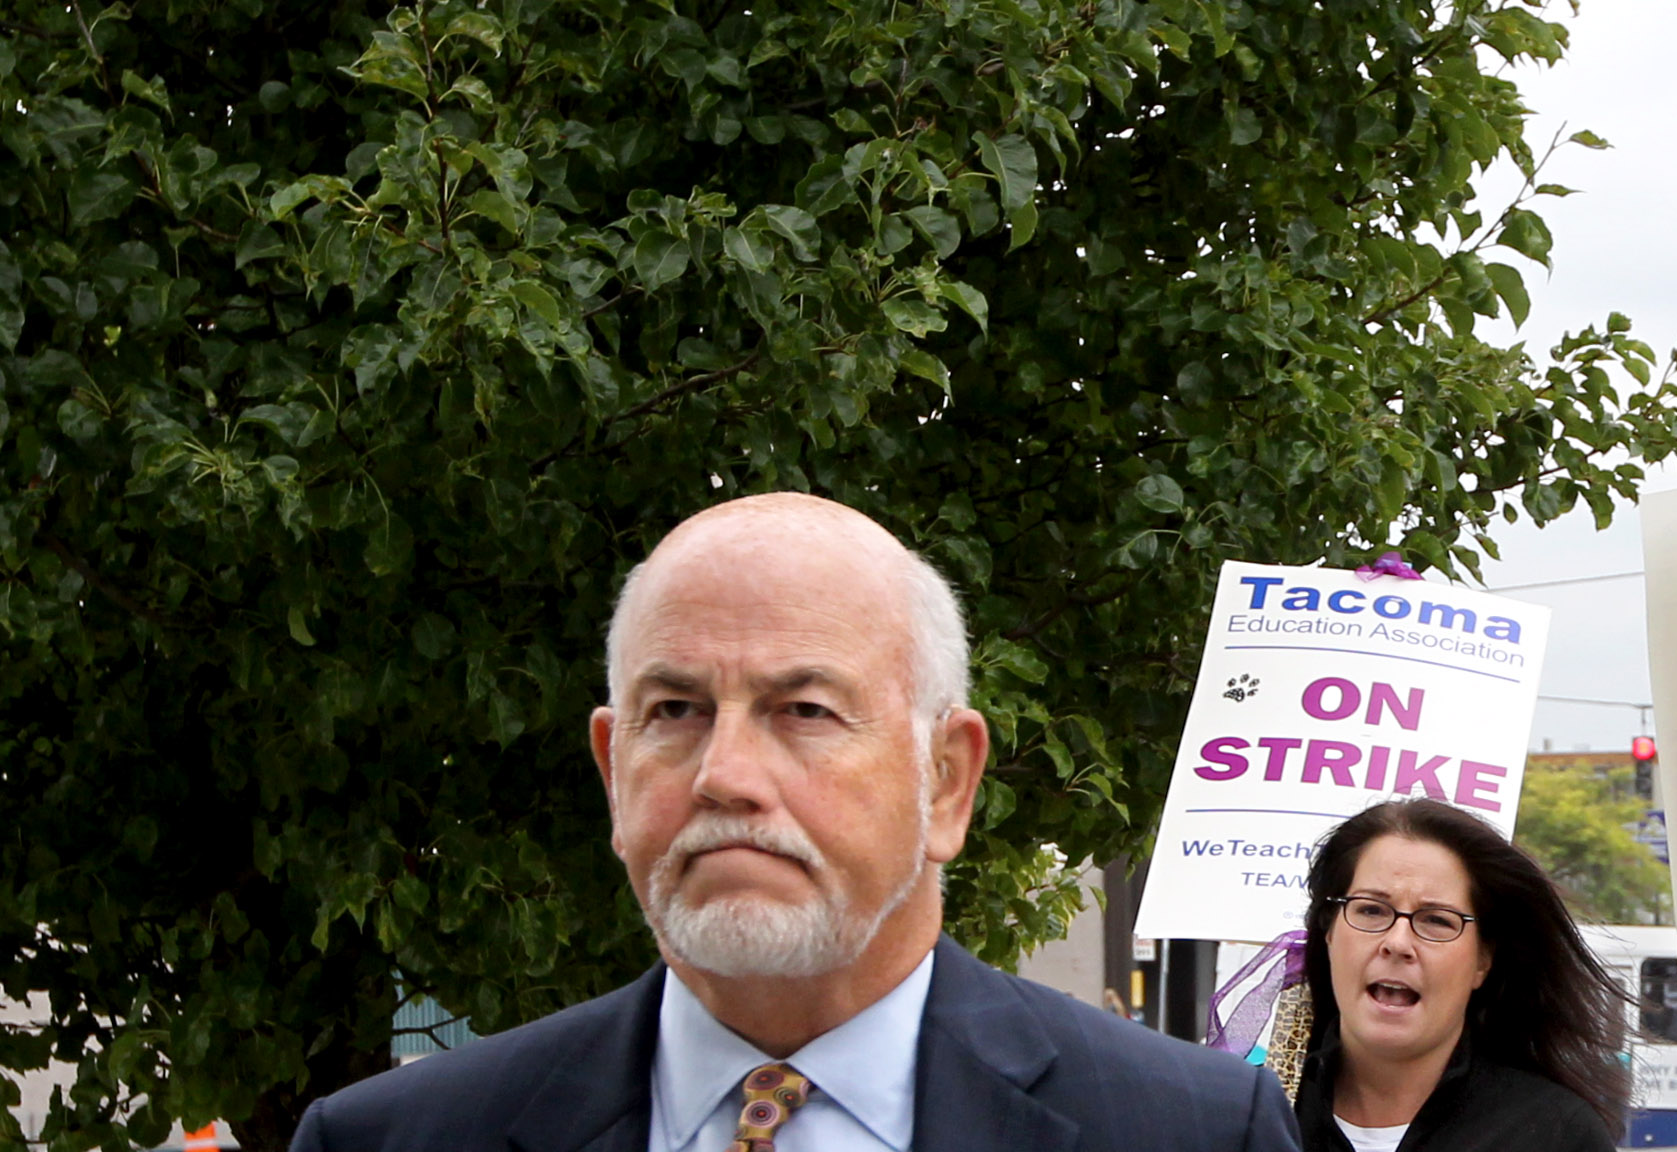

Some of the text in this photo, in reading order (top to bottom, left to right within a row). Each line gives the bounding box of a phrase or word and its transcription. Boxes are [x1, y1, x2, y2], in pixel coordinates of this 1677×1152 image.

[1227, 615, 1525, 667] Education Association
[1240, 576, 1522, 645] Tacoma
[1301, 677, 1425, 731] ON
[1193, 736, 1508, 813] STRIKE
